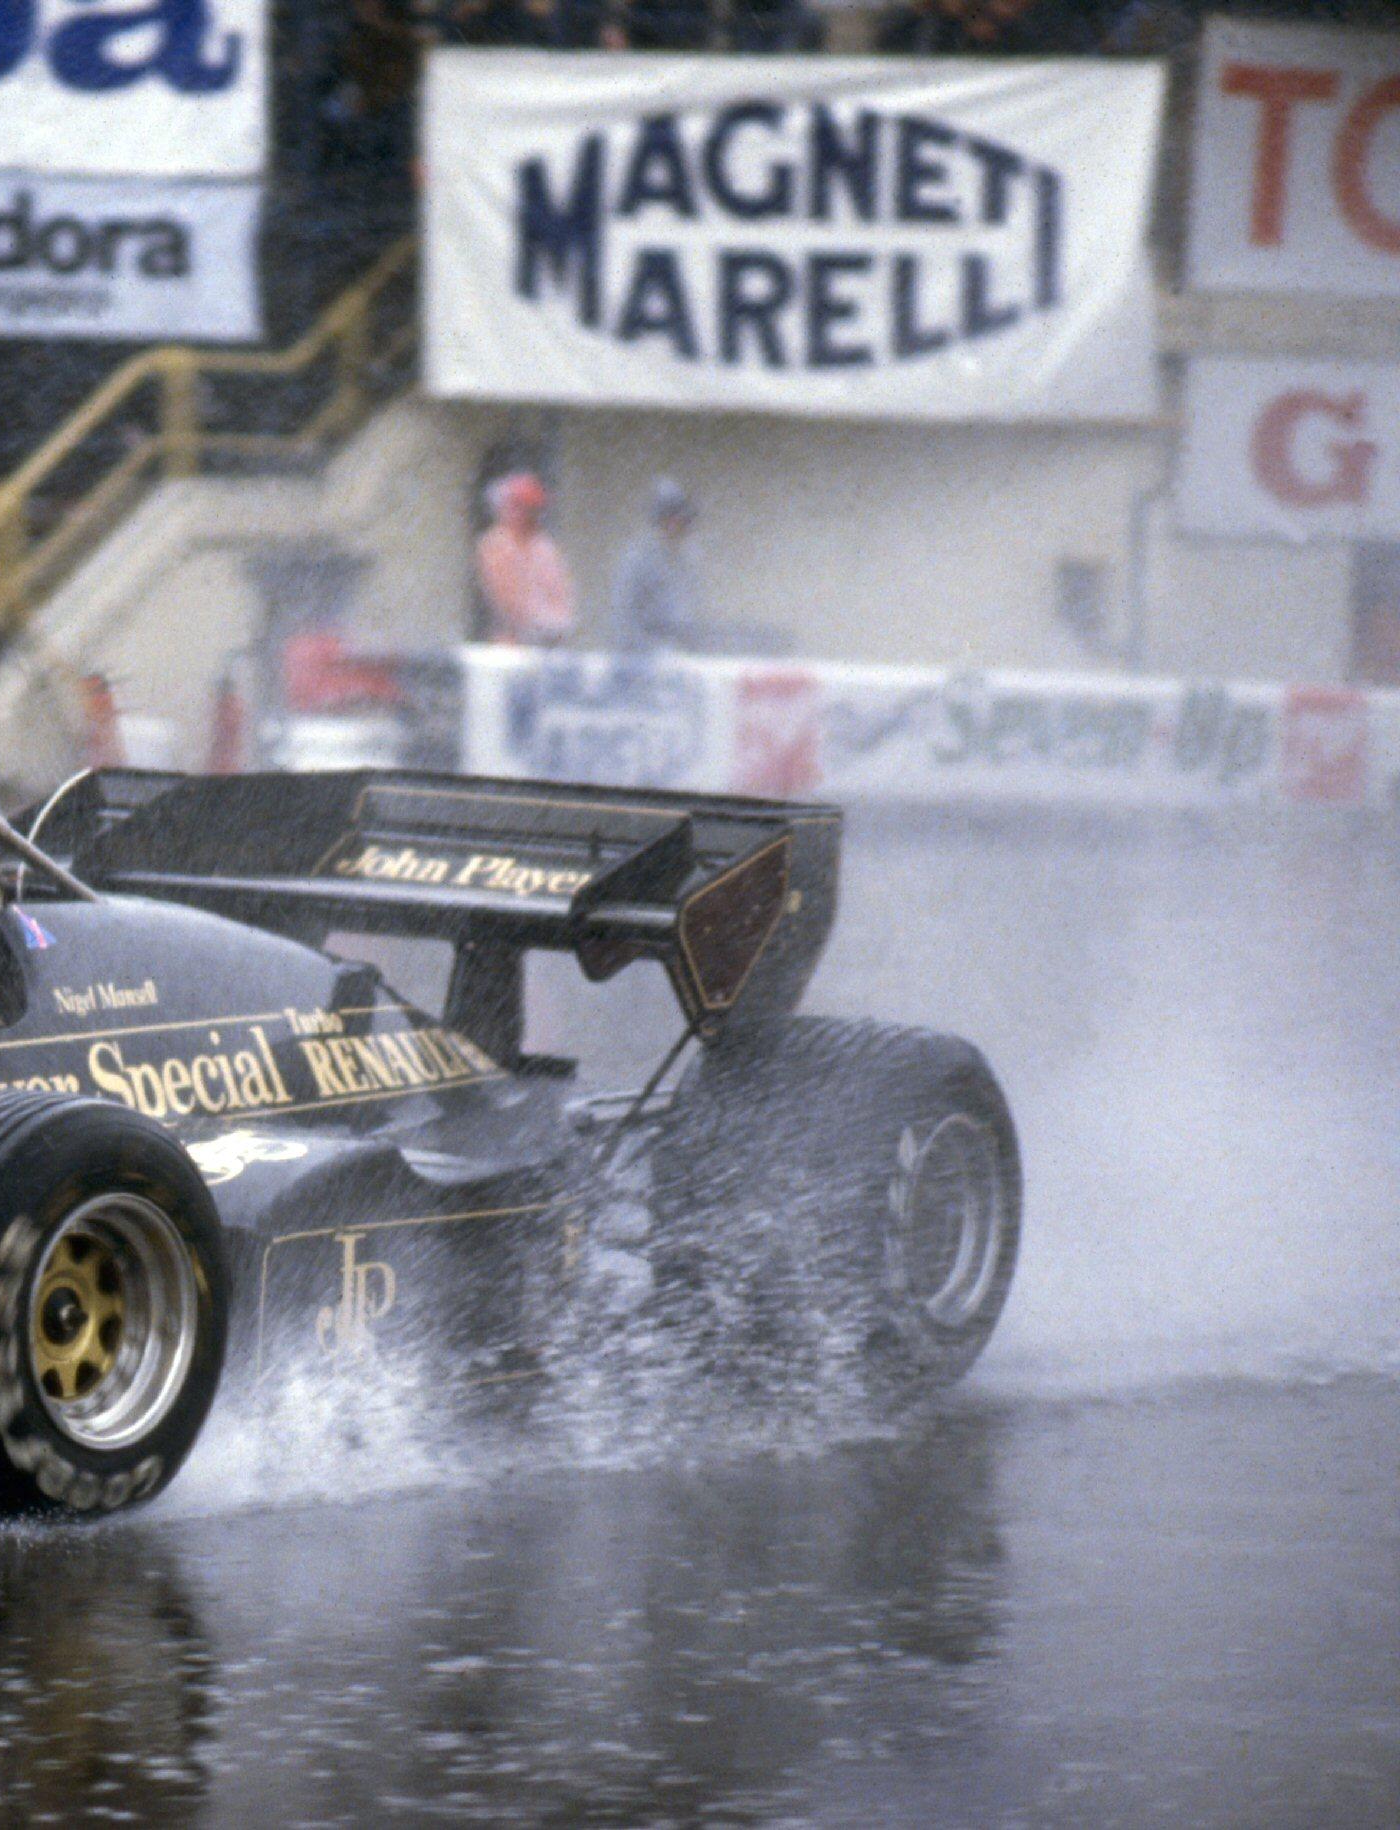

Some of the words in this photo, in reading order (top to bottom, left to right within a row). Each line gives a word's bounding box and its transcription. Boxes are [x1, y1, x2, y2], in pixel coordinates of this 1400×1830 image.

[512, 100, 1062, 275] MAGNETI
[512, 190, 1062, 371] MARELLI
[338, 846, 445, 880] John
[88, 1025, 293, 1118] Special
